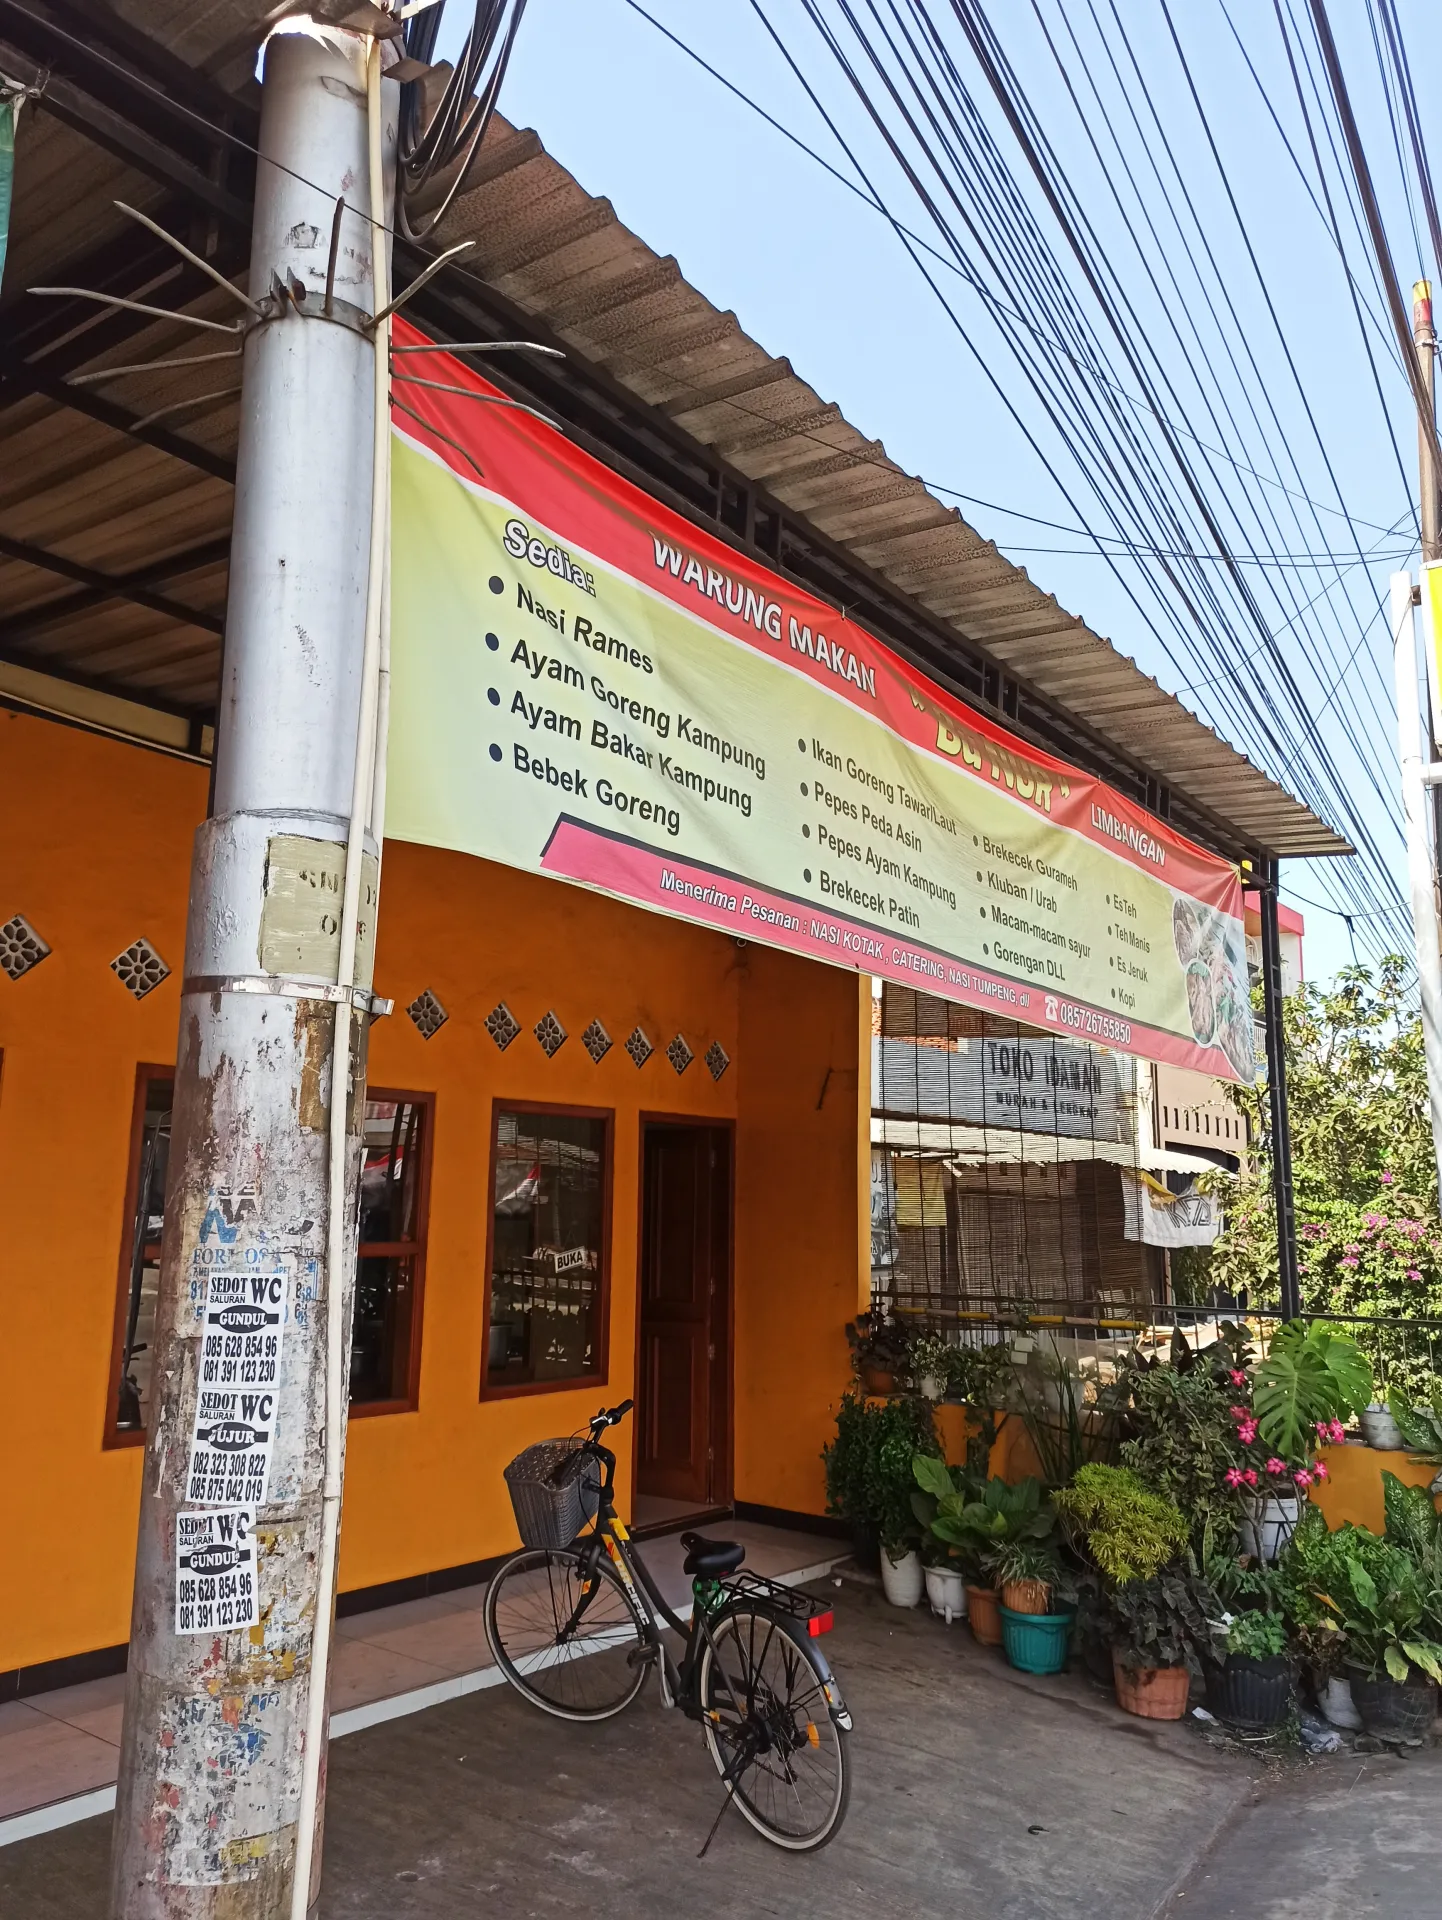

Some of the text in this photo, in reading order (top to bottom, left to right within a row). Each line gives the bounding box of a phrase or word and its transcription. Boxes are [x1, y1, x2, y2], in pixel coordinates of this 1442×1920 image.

[503, 518, 597, 598] Sedia:
[517, 582, 654, 675] Nasi Rames
[650, 532, 877, 699] WARUNG MAKAN
[510, 638, 766, 781] Ayam Goreng Kampung
[510, 689, 752, 818] Ayam Bakar Kampung
[513, 743, 681, 837] Bebek Goreng
[812, 738, 957, 835] Ikan Goreng Tawar/Laut
[815, 781, 922, 852] Pepes Peda Asin
[1091, 802, 1166, 866] LIMBANGAN
[818, 824, 956, 910] Pepes Ayam Kampung
[983, 836, 1078, 891] Brekecek Gurameh
[820, 870, 920, 929] Brekecek Patin
[988, 871, 1027, 900] Kluban
[1036, 889, 1058, 913] Urab
[991, 905, 1091, 959] Macam-macam sayur
[1115, 923, 1150, 953] Teh Manis
[660, 868, 736, 912] Menerima
[740, 895, 800, 932] Pesanan
[810, 919, 841, 946] NASI
[949, 967, 970, 989] NASI
[1060, 1002, 1132, 1044] 085726755850
[994, 941, 1066, 981] Gorengan DLL
[1117, 955, 1148, 982] Es Jeruk
[1118, 987, 1136, 1009] Kopi
[988, 1042, 1034, 1082] TOKO
[557, 1250, 583, 1269] BUKA
[209, 1295, 246, 1304] SALURAN
[210, 1277, 248, 1294] SEDOT
[251, 1277, 282, 1304] WC
[219, 1312, 268, 1326] GUNDUL
[206, 1335, 277, 1357] 085 628 854 96
[203, 1359, 275, 1382] 081 391 123 230
[199, 1410, 235, 1420] SALURAN
[201, 1392, 273, 1422] SEDOT WC
[208, 1429, 256, 1444] JUJUR
[193, 1451, 266, 1476] 082 323 308 822
[190, 1476, 263, 1502] 085 875 042 019
[217, 1512, 250, 1542] WC
[190, 1551, 240, 1568] GUNDUL
[180, 1572, 252, 1603] 085 628 854 96
[614, 1560, 650, 1626] PACIFIC
[180, 1598, 252, 1629] 081 391 123 230
